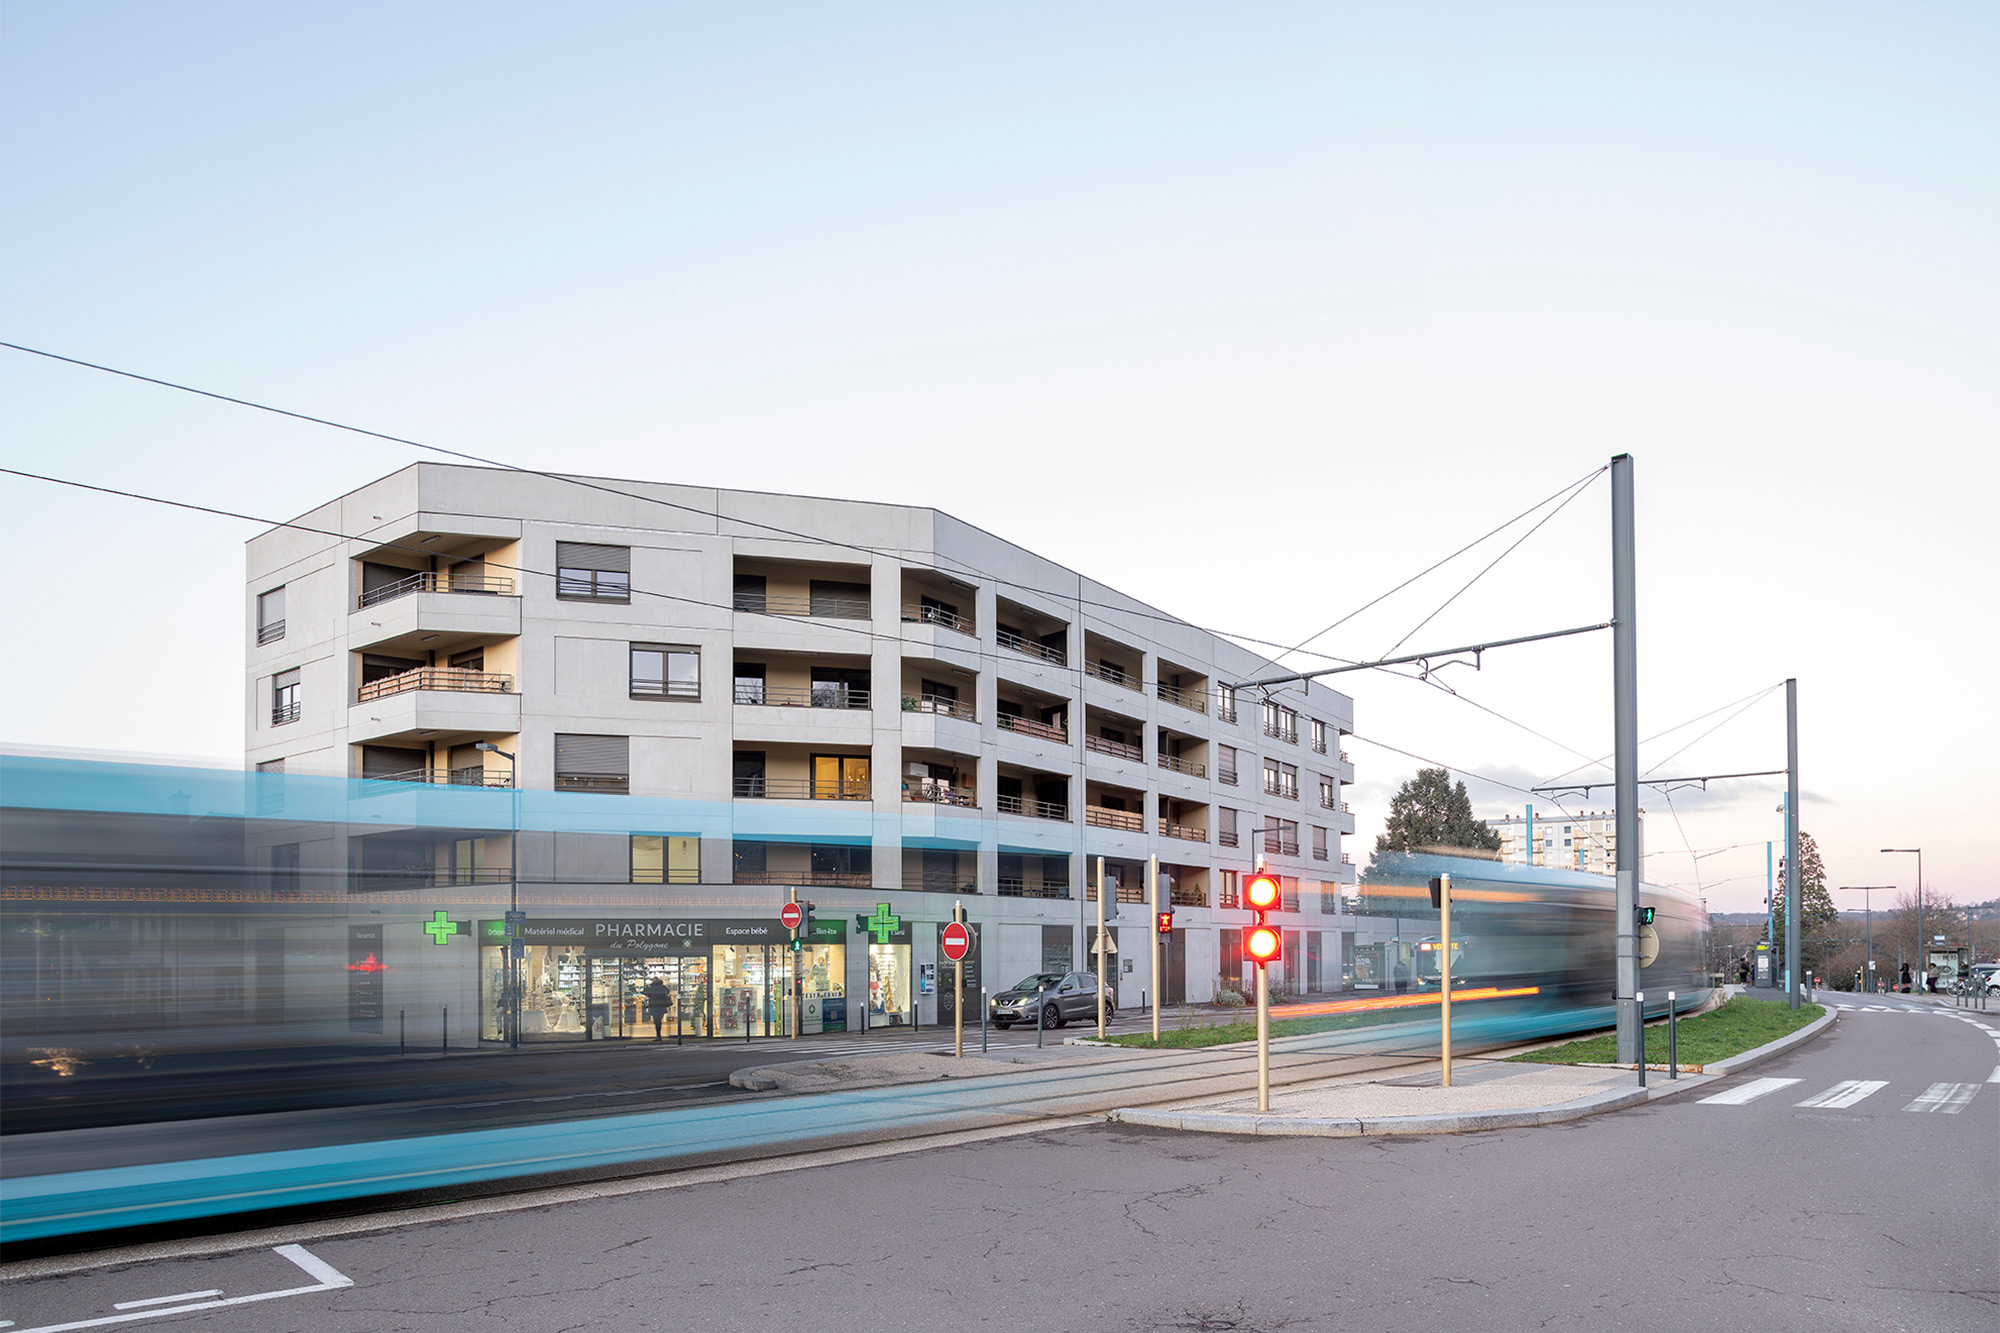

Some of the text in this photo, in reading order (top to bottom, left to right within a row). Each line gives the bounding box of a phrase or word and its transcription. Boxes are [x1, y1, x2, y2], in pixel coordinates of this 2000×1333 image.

[524, 927, 585, 935] Matériel médical
[595, 923, 703, 937] PHARMACIE
[725, 926, 768, 936] Espace bébé
[609, 939, 669, 952] du Polygone
